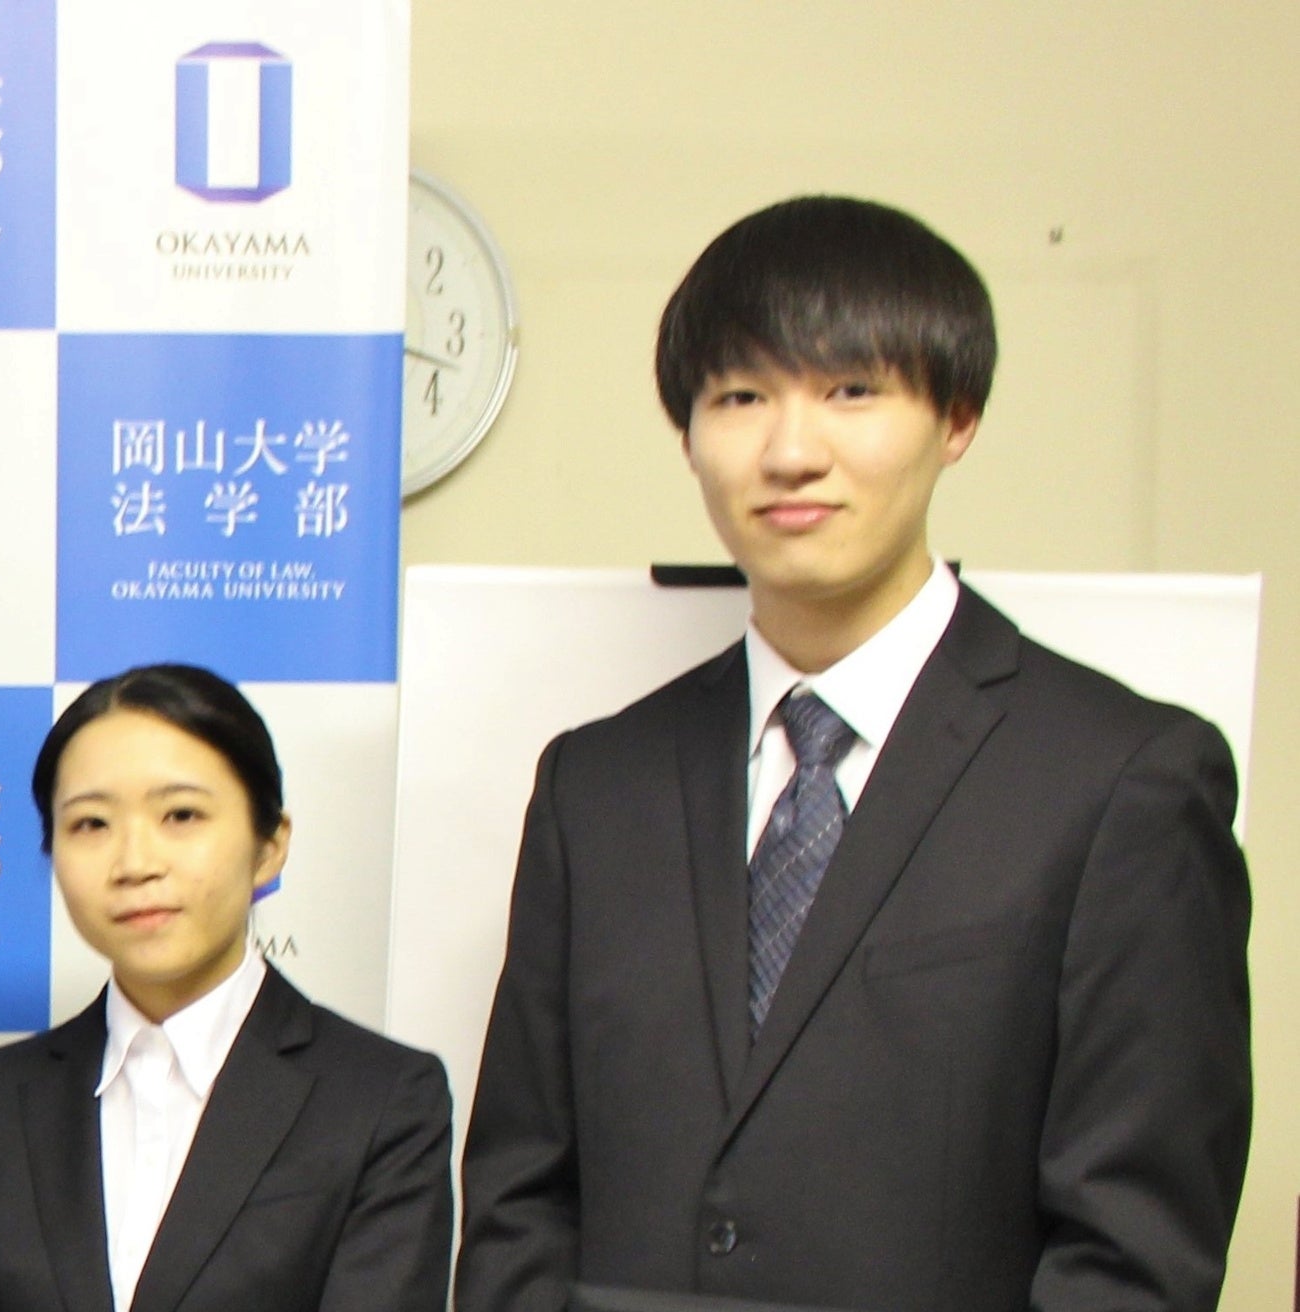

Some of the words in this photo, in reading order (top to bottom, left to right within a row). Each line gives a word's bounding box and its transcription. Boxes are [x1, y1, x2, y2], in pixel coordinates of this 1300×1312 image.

[155, 231, 310, 258] OKAYAMA
[172, 264, 294, 282] UNIVERSITY
[425, 246, 444, 297] 2
[446, 312, 466, 360] 3
[423, 368, 445, 416] 4
[112, 419, 351, 477] 岡山大学
[111, 482, 350, 538] 法学部
[111, 580, 214, 599] OKAYAMA
[223, 581, 346, 600] UNIVERSITY
[149, 561, 235, 580] FACULTY
[239, 561, 264, 579] OF
